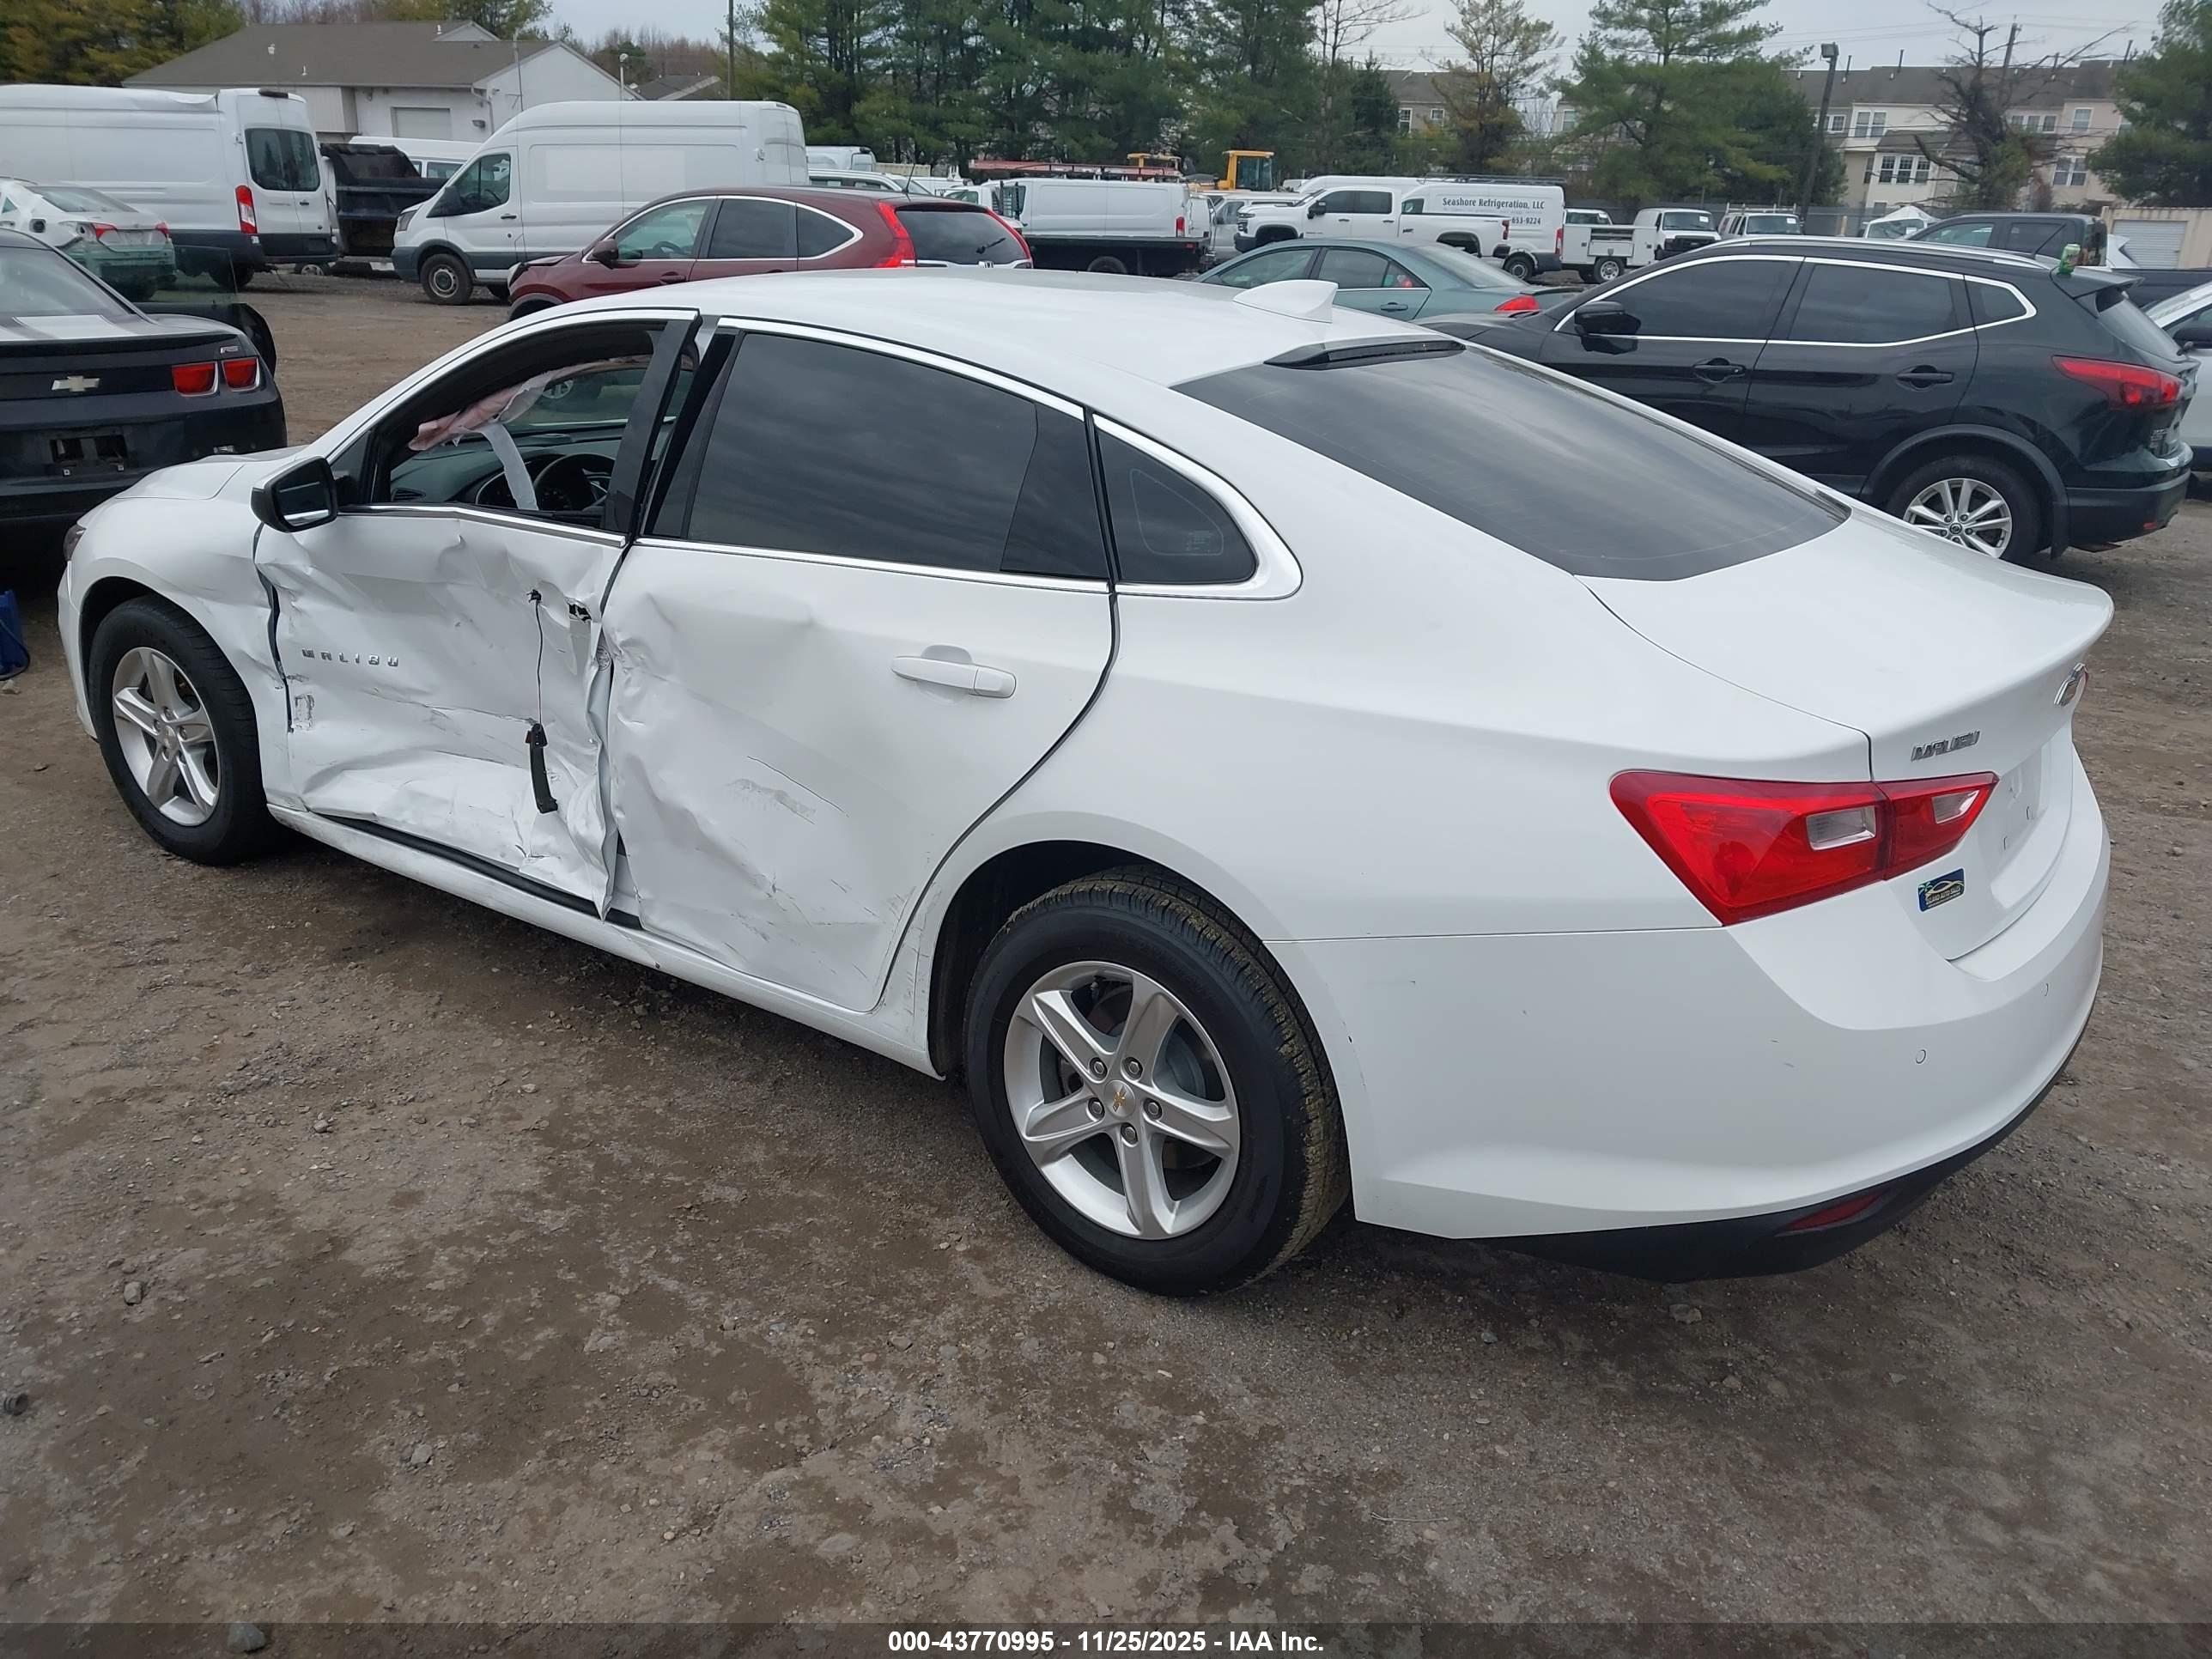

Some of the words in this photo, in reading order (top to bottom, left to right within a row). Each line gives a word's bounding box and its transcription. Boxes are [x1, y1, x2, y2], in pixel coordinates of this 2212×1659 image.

[1443, 198, 1476, 207] Seashore
[1479, 198, 1530, 210] Refrigeration,
[1533, 201, 1545, 210] LLC
[302, 647, 399, 667] MALIBU
[1911, 730, 1981, 763] MALIBU
